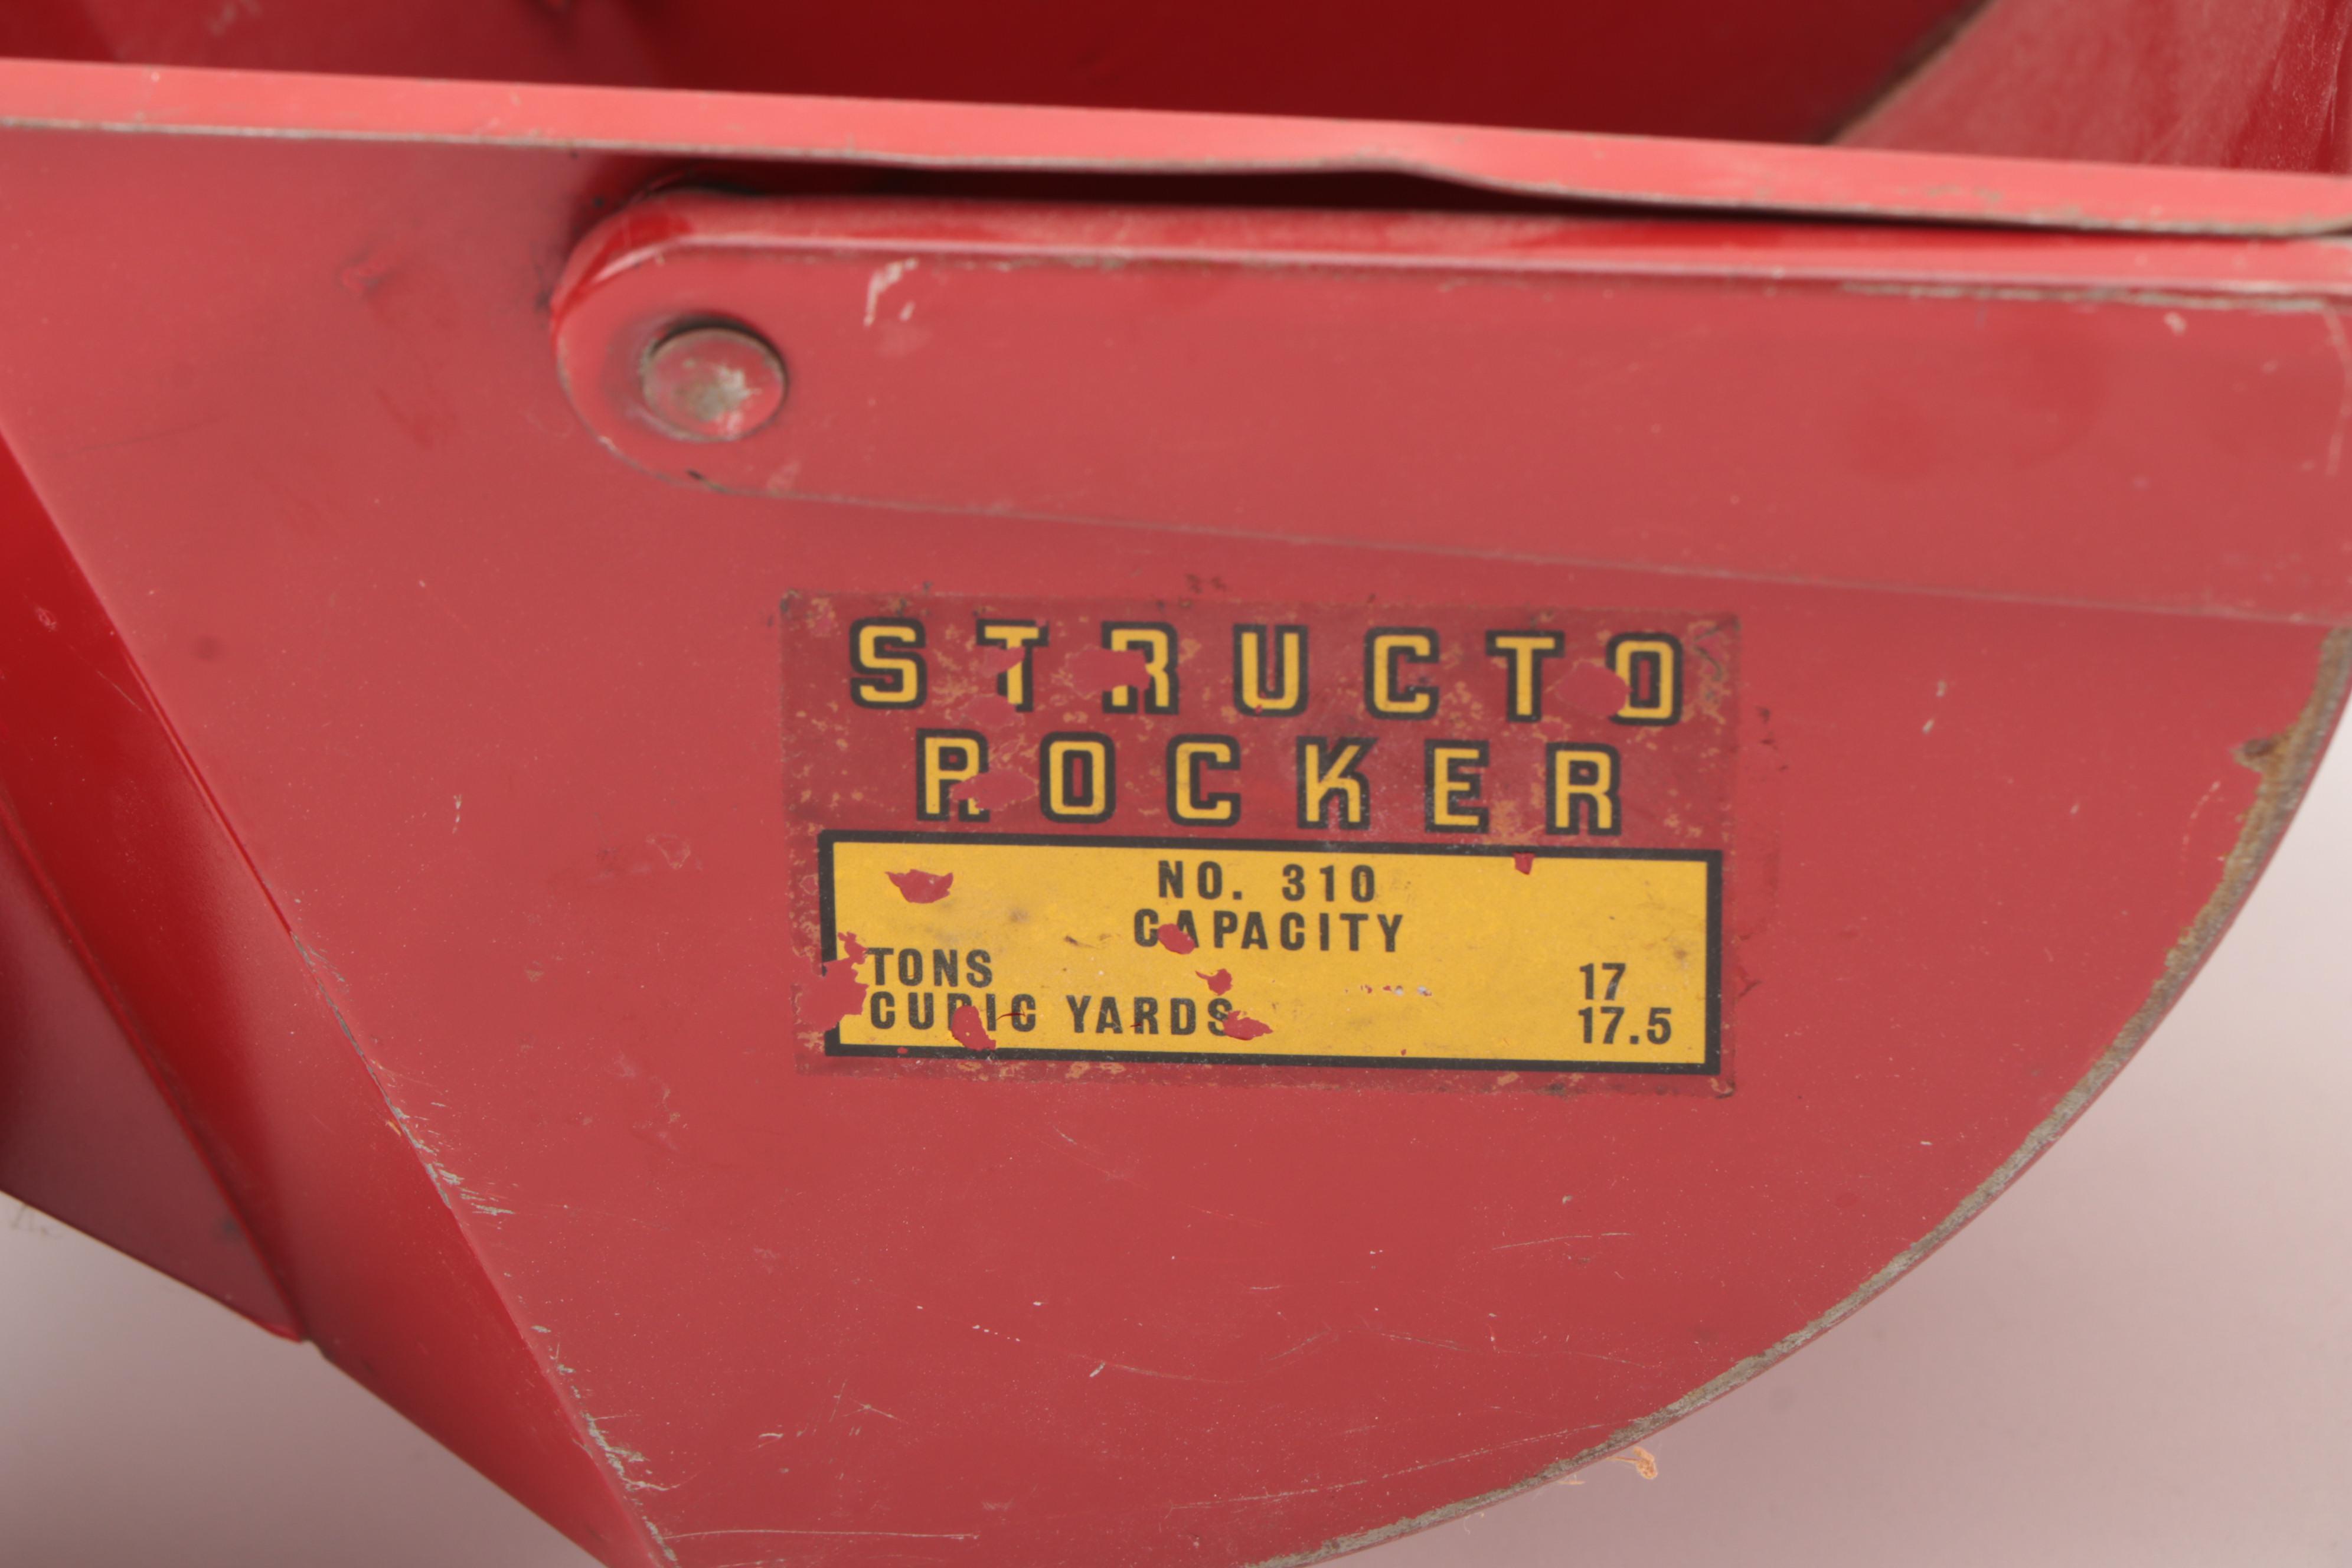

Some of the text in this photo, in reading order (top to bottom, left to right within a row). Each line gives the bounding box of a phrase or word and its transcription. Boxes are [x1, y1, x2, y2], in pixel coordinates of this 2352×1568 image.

[849, 617, 1683, 727] STRUCTO
[916, 727, 1622, 837] ROCKER
[1158, 860, 1376, 903] NO. 310
[870, 947, 1626, 1001] TONS 17
[1066, 995, 1234, 1037] YARDS
[1577, 1007, 1672, 1045] 17.5
